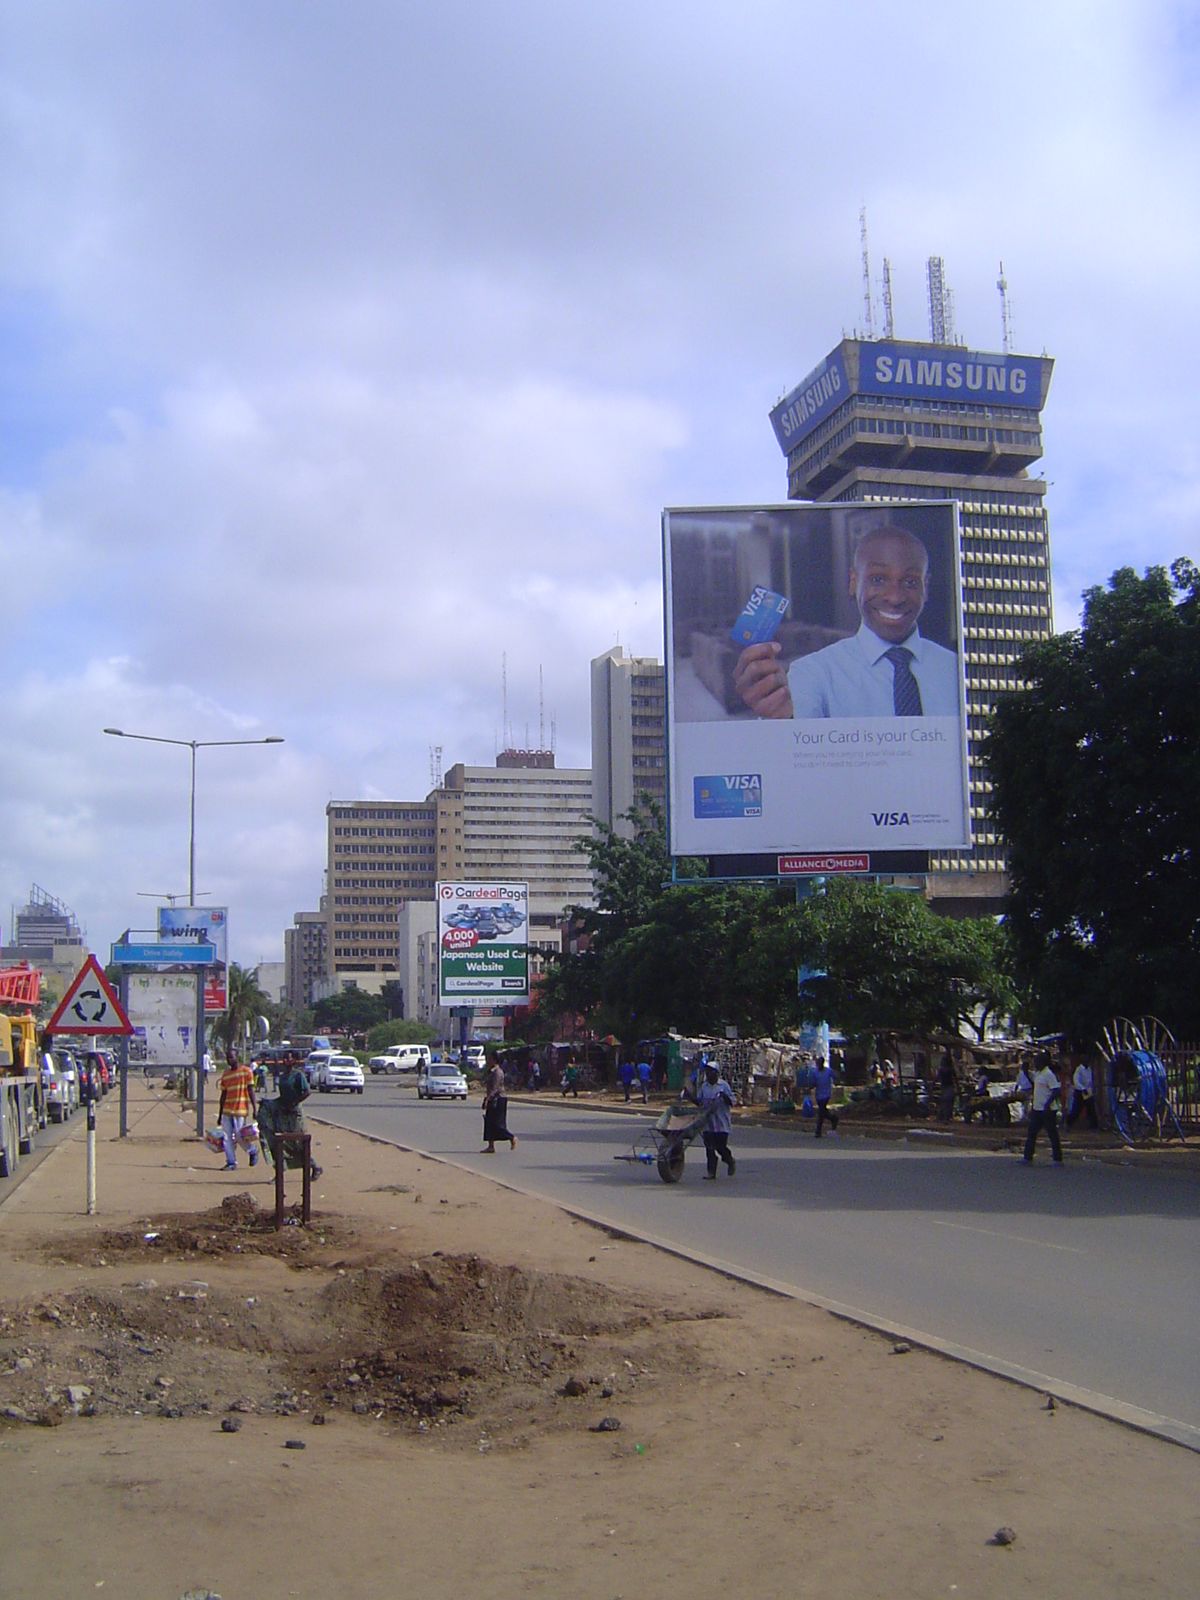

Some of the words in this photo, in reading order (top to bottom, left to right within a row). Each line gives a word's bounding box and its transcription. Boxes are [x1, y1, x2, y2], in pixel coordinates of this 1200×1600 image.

[875, 355, 1027, 394] SAMSUNG
[780, 365, 841, 438] SAMSUNG
[742, 587, 767, 616] VISA
[793, 731, 824, 744] Your
[828, 730, 860, 743] Card
[863, 730, 874, 743] is
[877, 731, 907, 745] your
[910, 728, 947, 742] Cash.
[722, 775, 760, 790] VISA
[871, 812, 910, 826] VISA
[784, 860, 826, 869] ALLIANCE
[835, 859, 864, 868] MEDIA
[455, 887, 528, 901] CardealPage
[442, 950, 485, 961] Japanese
[487, 949, 510, 959] Used
[466, 962, 504, 972] Website
